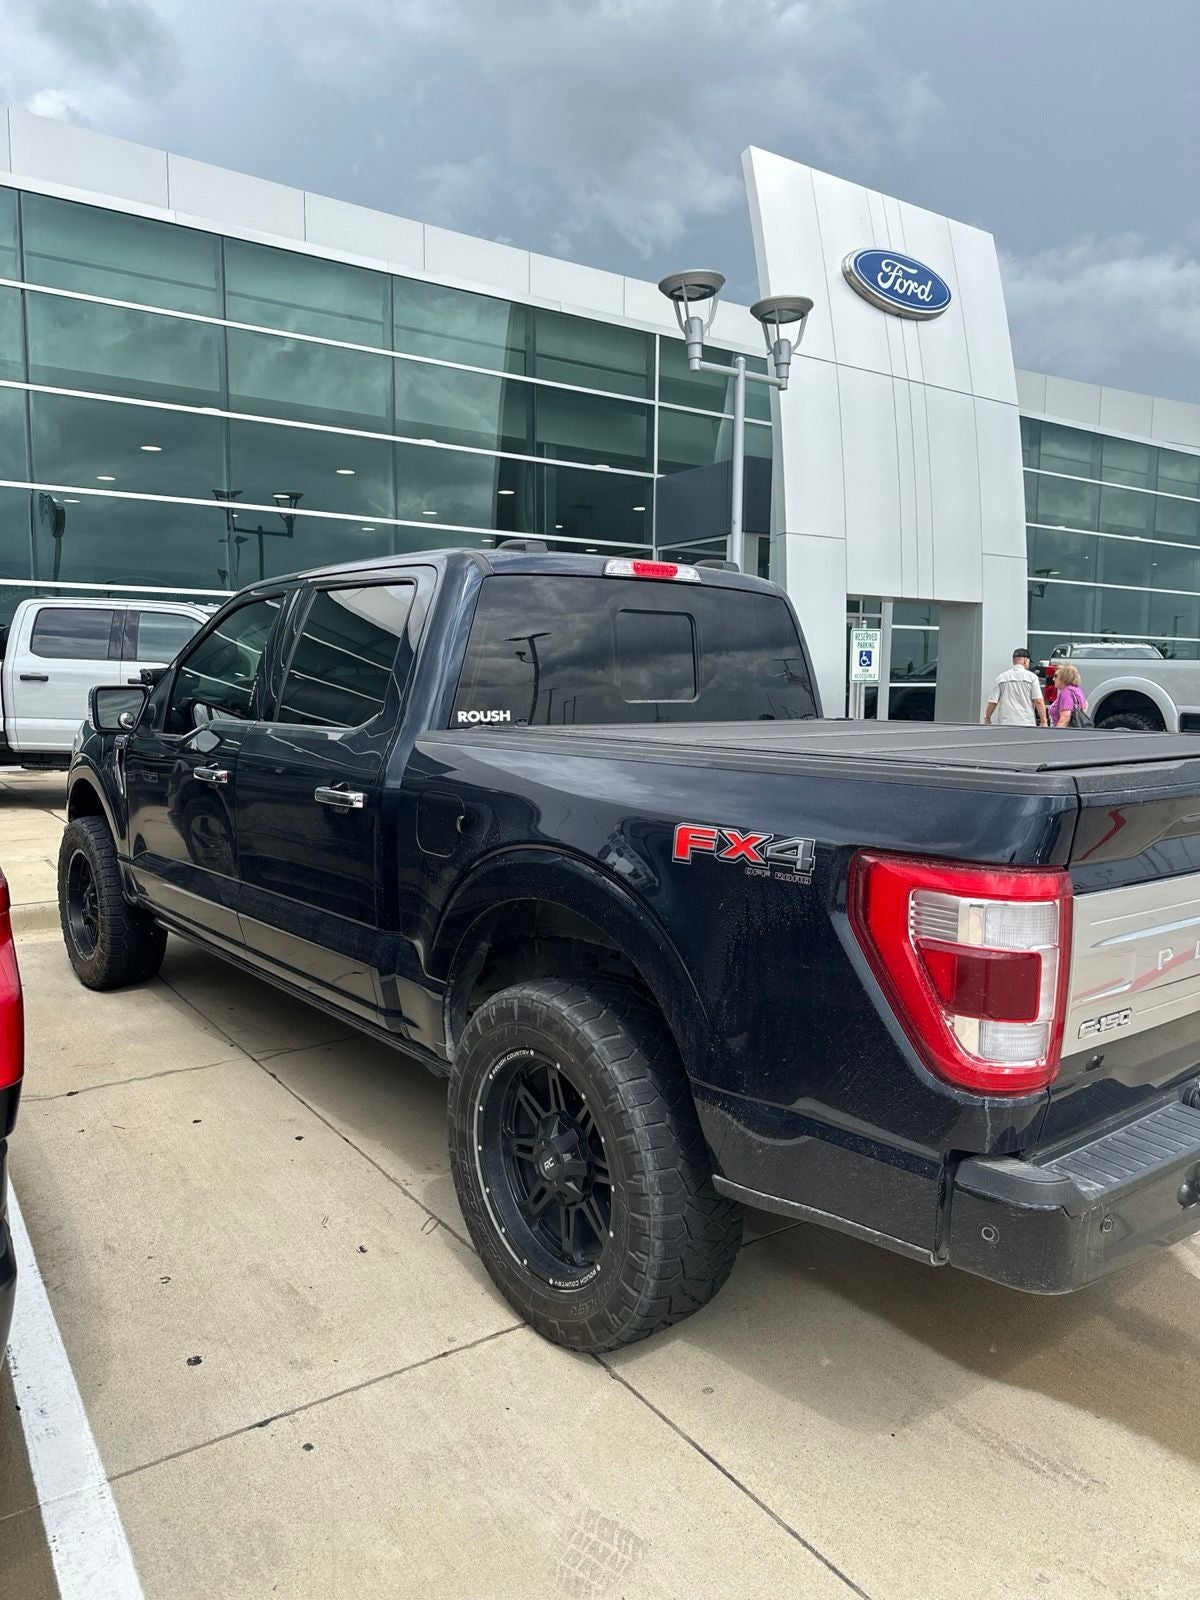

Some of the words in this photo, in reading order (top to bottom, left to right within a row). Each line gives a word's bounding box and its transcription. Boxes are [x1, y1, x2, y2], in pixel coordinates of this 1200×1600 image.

[877, 259, 933, 302] Ford
[855, 632, 878, 641] RESERVED
[857, 641, 875, 649] PARKING
[457, 710, 511, 722] ROUSH
[672, 822, 815, 876] FX4
[744, 866, 770, 877] OFF
[775, 871, 812, 884] ROAD
[1078, 1007, 1133, 1039] F-150
[492, 1057, 507, 1075] ROUGH
[506, 1049, 530, 1061] COUNTRY
[543, 1156, 555, 1171] RC
[553, 1279, 580, 1288] COUNTRY
[579, 1268, 597, 1285] ROUGH
